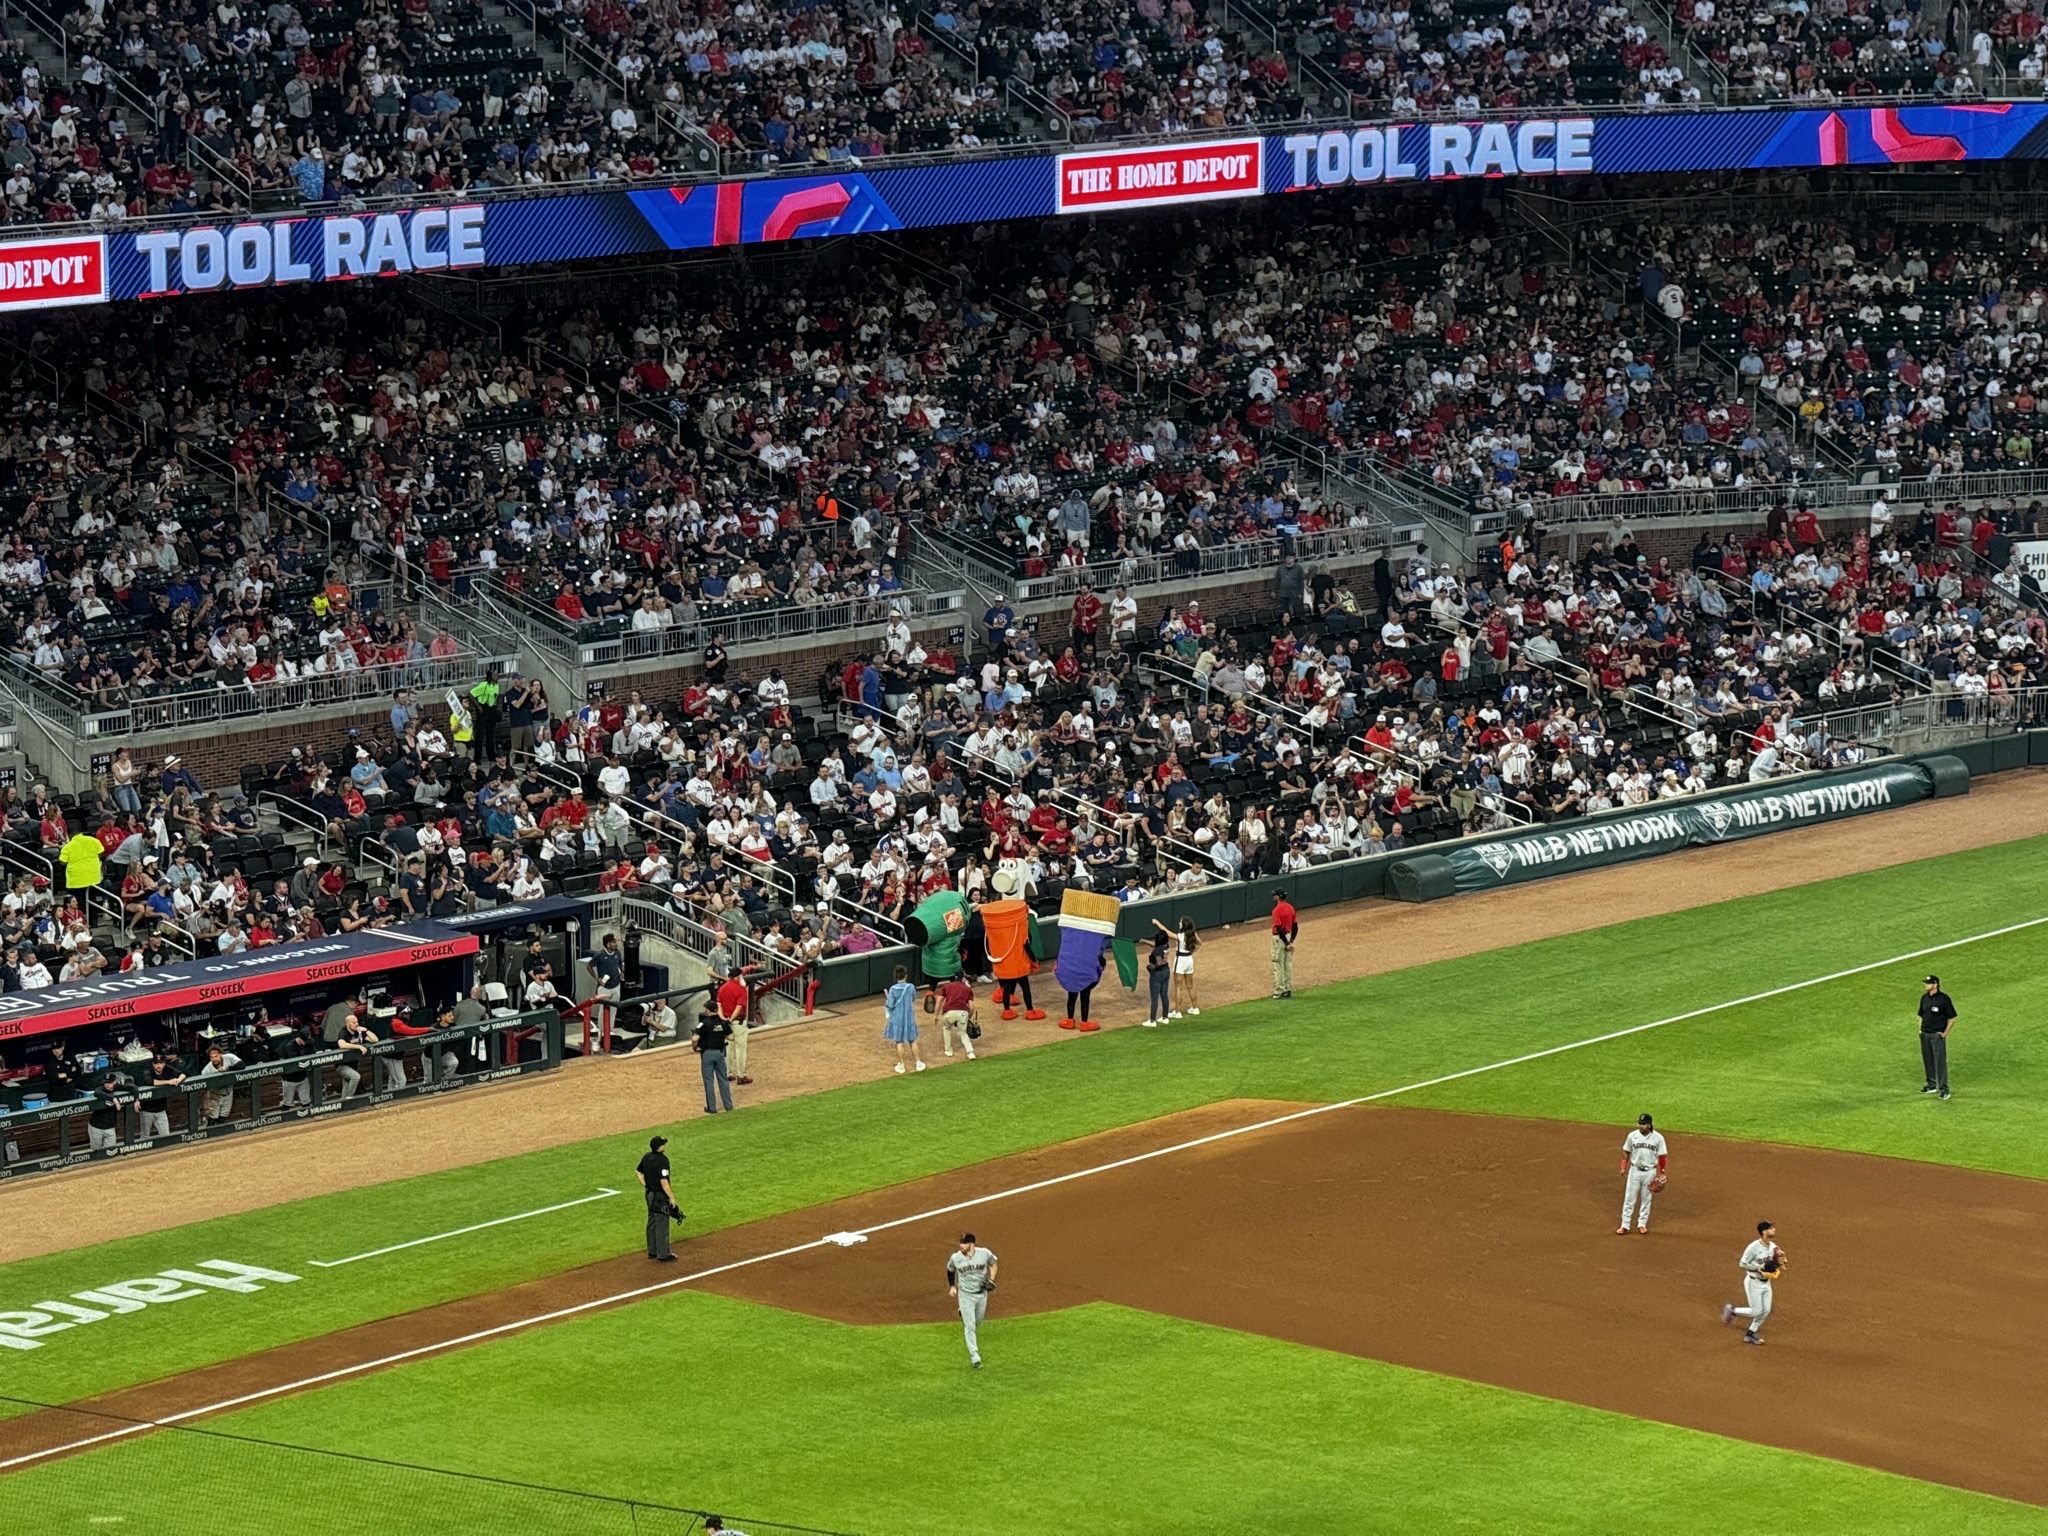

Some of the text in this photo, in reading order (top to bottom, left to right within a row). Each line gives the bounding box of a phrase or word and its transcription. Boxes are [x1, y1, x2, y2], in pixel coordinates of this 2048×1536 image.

[1285, 119, 1594, 187] TOOL RACE
[1067, 155, 1250, 194] THE HOME DEPOT
[136, 206, 486, 293] TOOL RACE
[0, 255, 89, 290] DEPOT
[1261, 376, 1269, 387] 5
[98, 755, 110, 764] 135
[1731, 777, 1891, 827] MLB NETWORK
[1511, 812, 1685, 867] MLB NETWORK
[205, 944, 351, 972] WELCOME TO
[411, 943, 455, 961] SEATGEEK
[307, 962, 352, 981] SEATGEEK
[41, 973, 191, 1003] TRUIST
[199, 981, 245, 1000] SEATGEEK
[88, 1001, 136, 1020] SEATGEEK
[39, 1104, 90, 1121] YanmarUS.com
[118, 1091, 153, 1104] YANAR
[180, 1081, 207, 1093] Tractors
[235, 1065, 284, 1082] YanmarUS.com
[311, 1053, 344, 1066] YANMAR
[370, 1043, 395, 1055] Tractors
[419, 1029, 465, 1046] YanmarUS.com
[491, 1018, 522, 1031] YANMAR
[39, 1153, 90, 1170] YanmarUS.com
[119, 1141, 153, 1154] YANMAR
[181, 1130, 208, 1142] Tractors
[234, 1115, 282, 1132] YanmarUS.com
[310, 1102, 342, 1115] YANMAR
[369, 1092, 394, 1104] Tractors
[418, 1078, 464, 1094] YanmarUS.com
[490, 1066, 521, 1079] YANMAR
